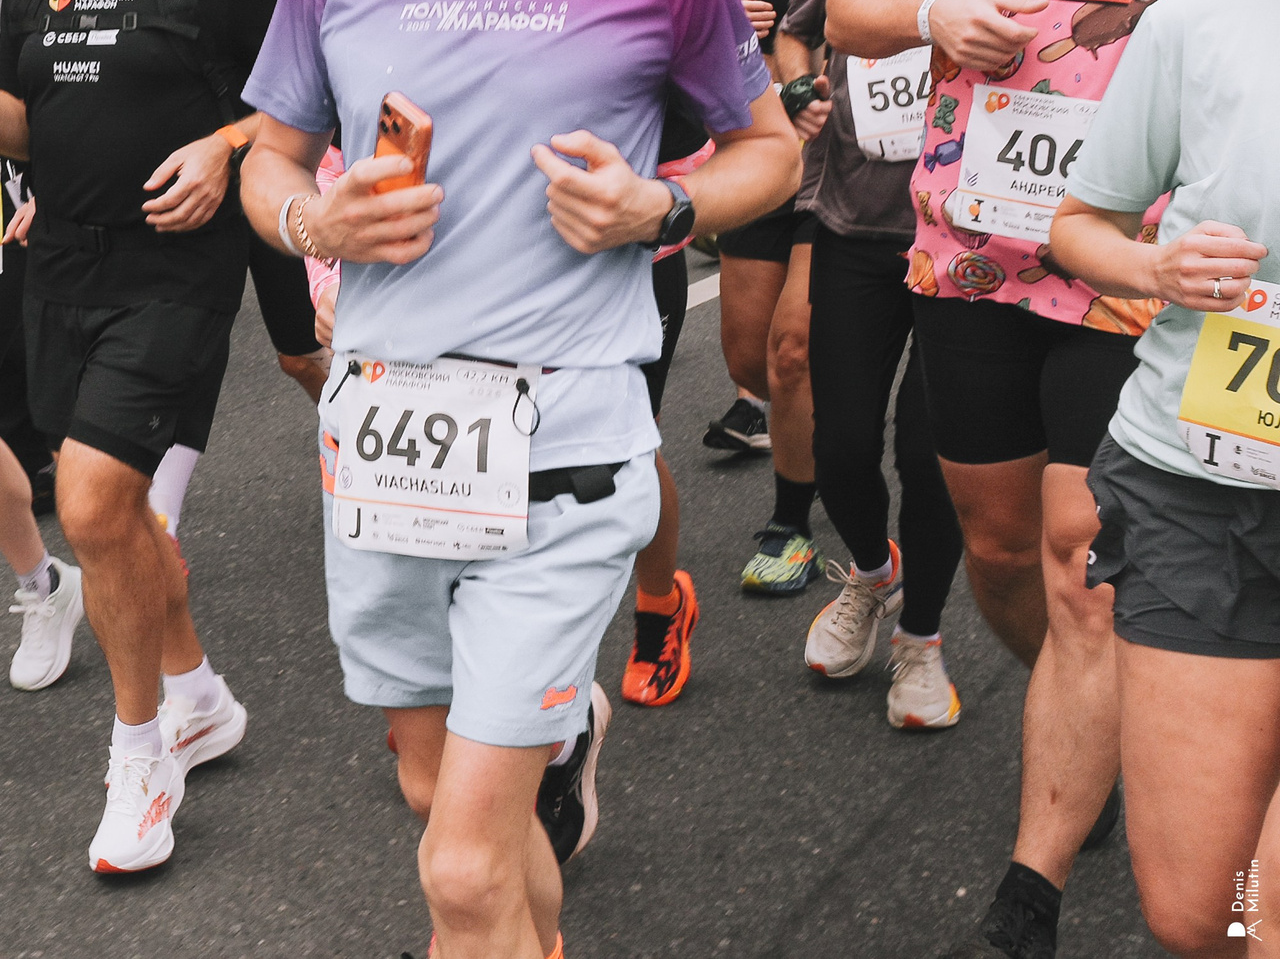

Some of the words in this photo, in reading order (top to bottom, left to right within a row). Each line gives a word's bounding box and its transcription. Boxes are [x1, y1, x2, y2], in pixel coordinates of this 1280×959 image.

[466, 0, 569, 14] МИНСКИЙ
[400, 1, 458, 21] ПОЛУ
[443, 11, 566, 33] МАРАФОН
[57, 32, 87, 44] СБЕР
[53, 61, 101, 74] HUAWEI
[1010, 180, 1066, 199] АНДРЕЙ
[463, 370, 487, 382] 42,2
[355, 405, 493, 474] 6491
[373, 473, 473, 498] VIACHASLAU
[348, 507, 362, 539] J
